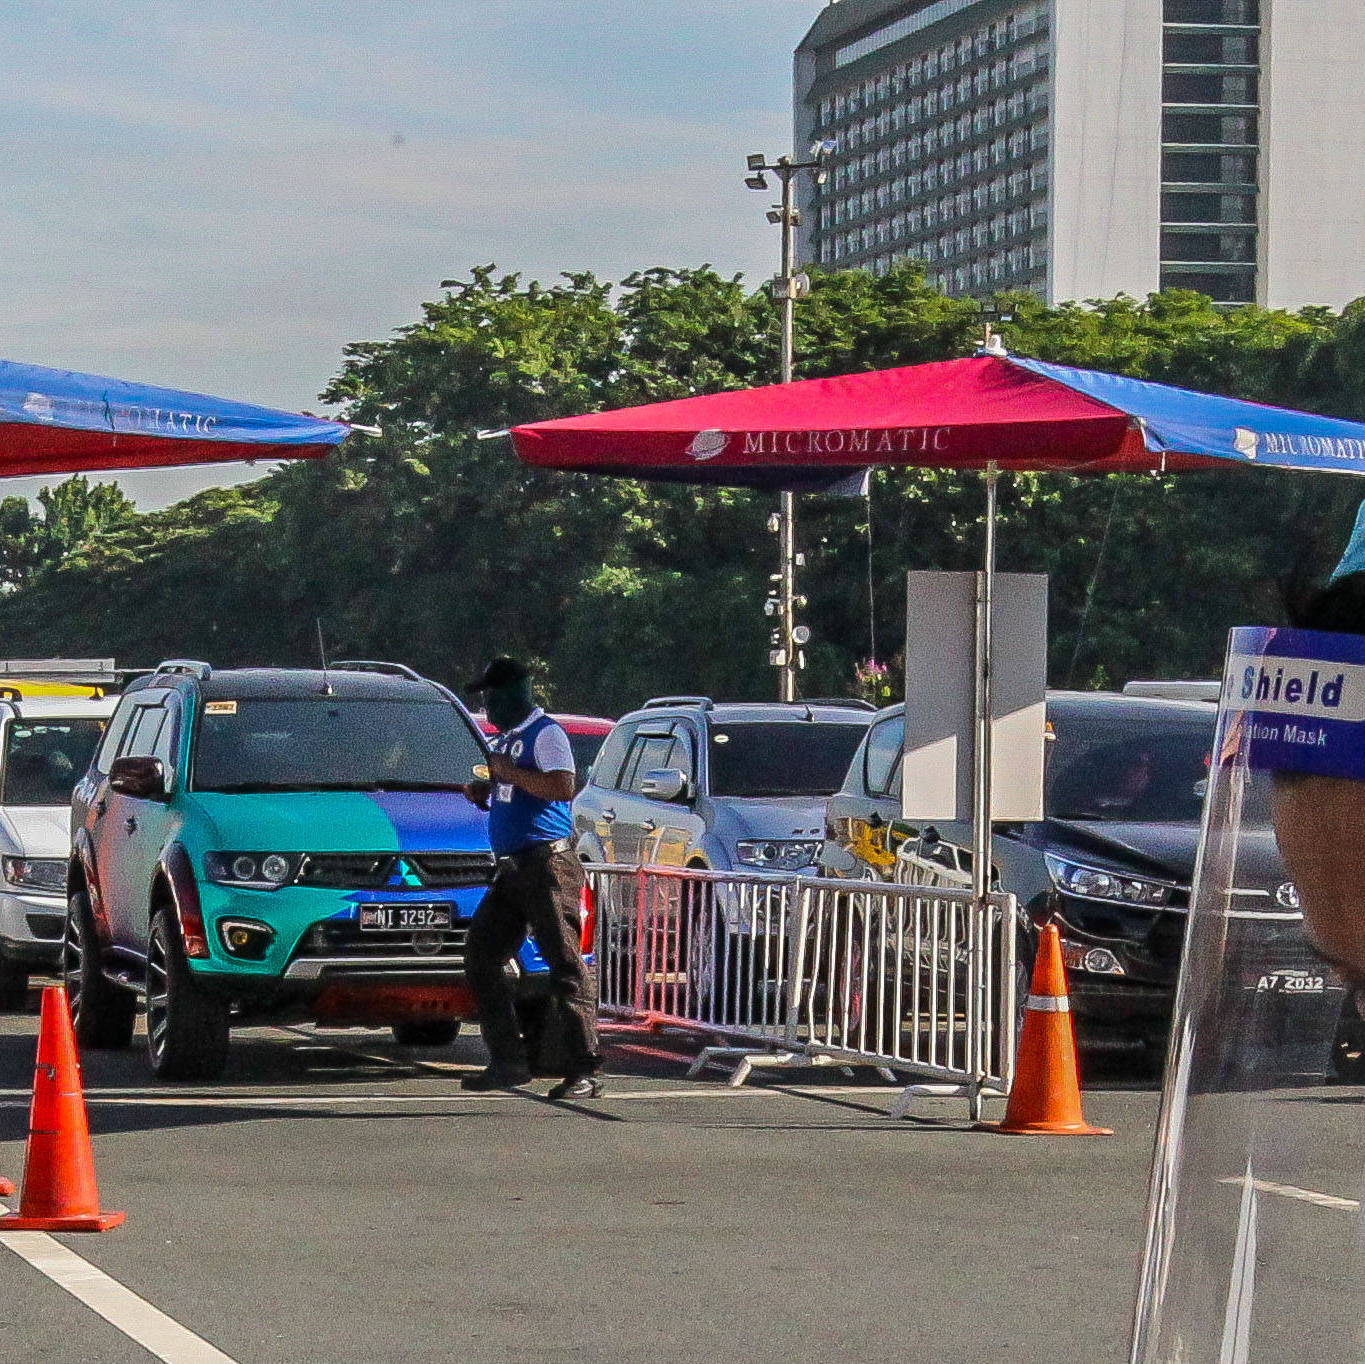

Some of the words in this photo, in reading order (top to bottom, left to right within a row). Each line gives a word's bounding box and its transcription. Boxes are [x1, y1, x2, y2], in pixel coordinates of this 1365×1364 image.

[742, 427, 951, 455] MICROMATIC
[1241, 666, 1344, 708] Shield
[1283, 724, 1327, 747] Mask
